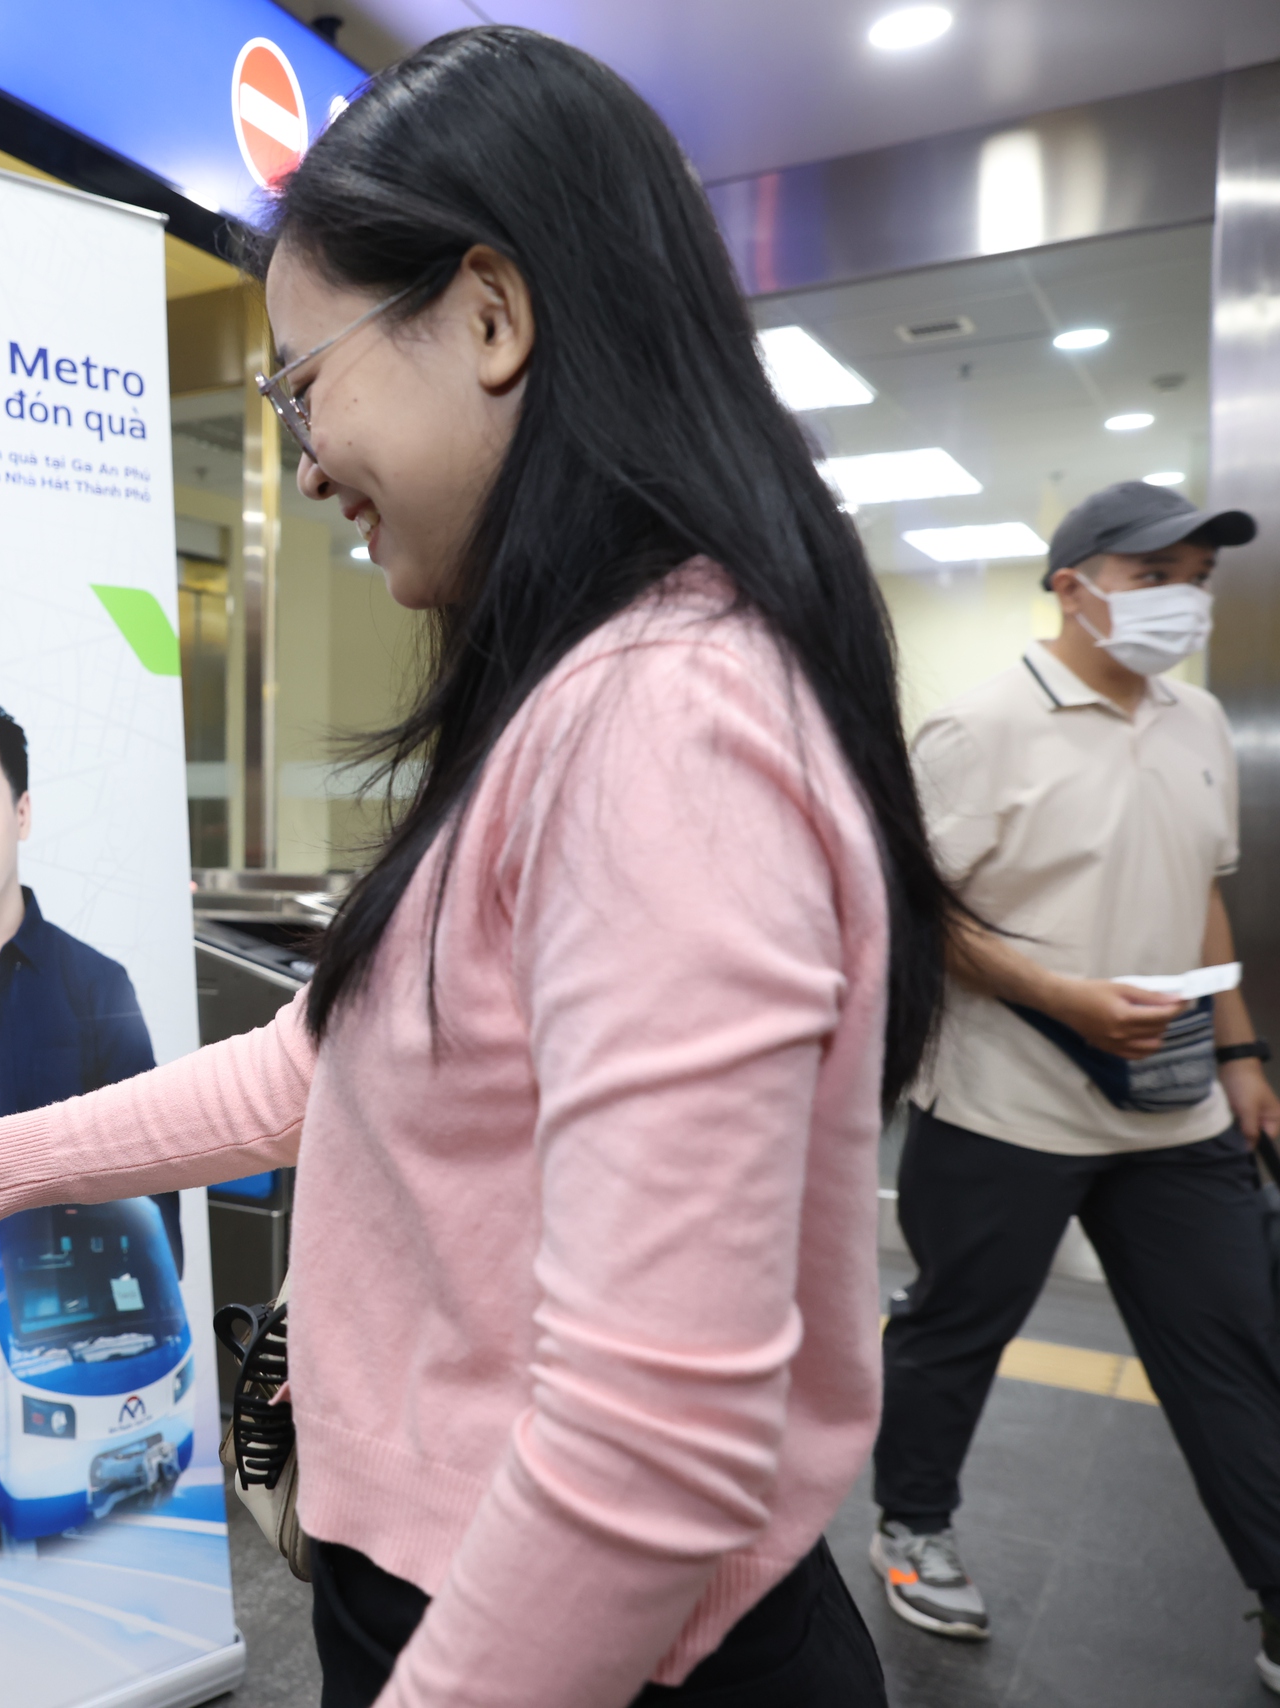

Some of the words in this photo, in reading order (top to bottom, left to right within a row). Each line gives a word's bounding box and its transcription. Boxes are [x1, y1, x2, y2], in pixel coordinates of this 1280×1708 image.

[9, 340, 145, 398] Metro
[4, 390, 73, 427] đón
[84, 407, 148, 442] quà
[5, 470, 37, 487] Nhà
[76, 480, 122, 498] Thành
[8, 451, 38, 467] quà
[44, 455, 66, 470] tại
[71, 458, 93, 474] Ga
[99, 461, 119, 477] An
